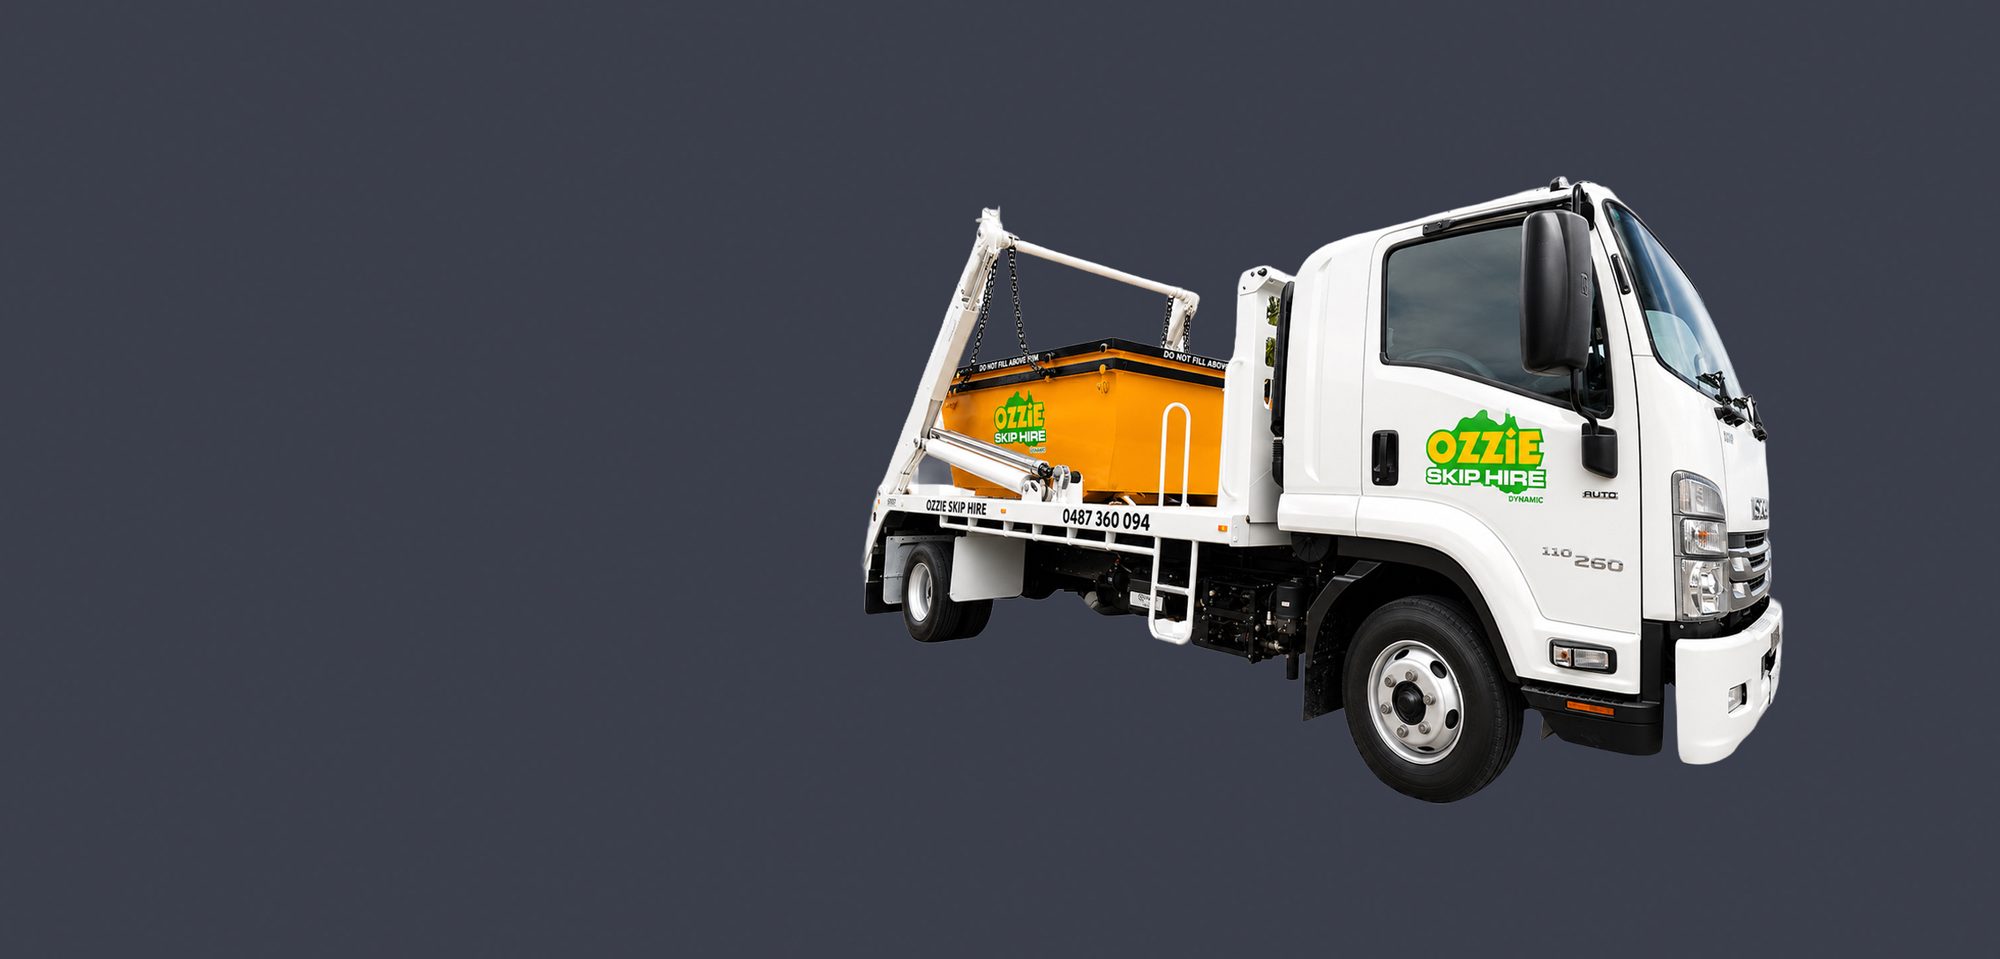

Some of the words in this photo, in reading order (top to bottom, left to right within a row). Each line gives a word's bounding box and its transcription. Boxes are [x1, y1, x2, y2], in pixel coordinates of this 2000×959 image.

[979, 364, 987, 372] DO
[987, 361, 997, 370] NOT
[998, 360, 1008, 368] FILL
[1009, 356, 1026, 367] ABOVE
[1163, 350, 1175, 359] DO
[1176, 353, 1191, 363] NOT
[1192, 356, 1206, 366] FILL
[994, 432, 1018, 443] SKIP
[1019, 430, 1046, 442] HIRE
[1427, 468, 1480, 484] SKIP
[1485, 469, 1545, 487] HIRE
[1508, 495, 1544, 504] DYNAMIC
[1582, 490, 1618, 500] AUTO
[926, 499, 947, 512] OZZIE
[948, 500, 966, 513] SKIP
[967, 502, 987, 515] HIRE
[1063, 508, 1093, 525] 0487
[1095, 510, 1119, 528] 360
[1123, 512, 1150, 531] 094
[1542, 546, 1572, 558] 110
[1574, 555, 1624, 572] 260
